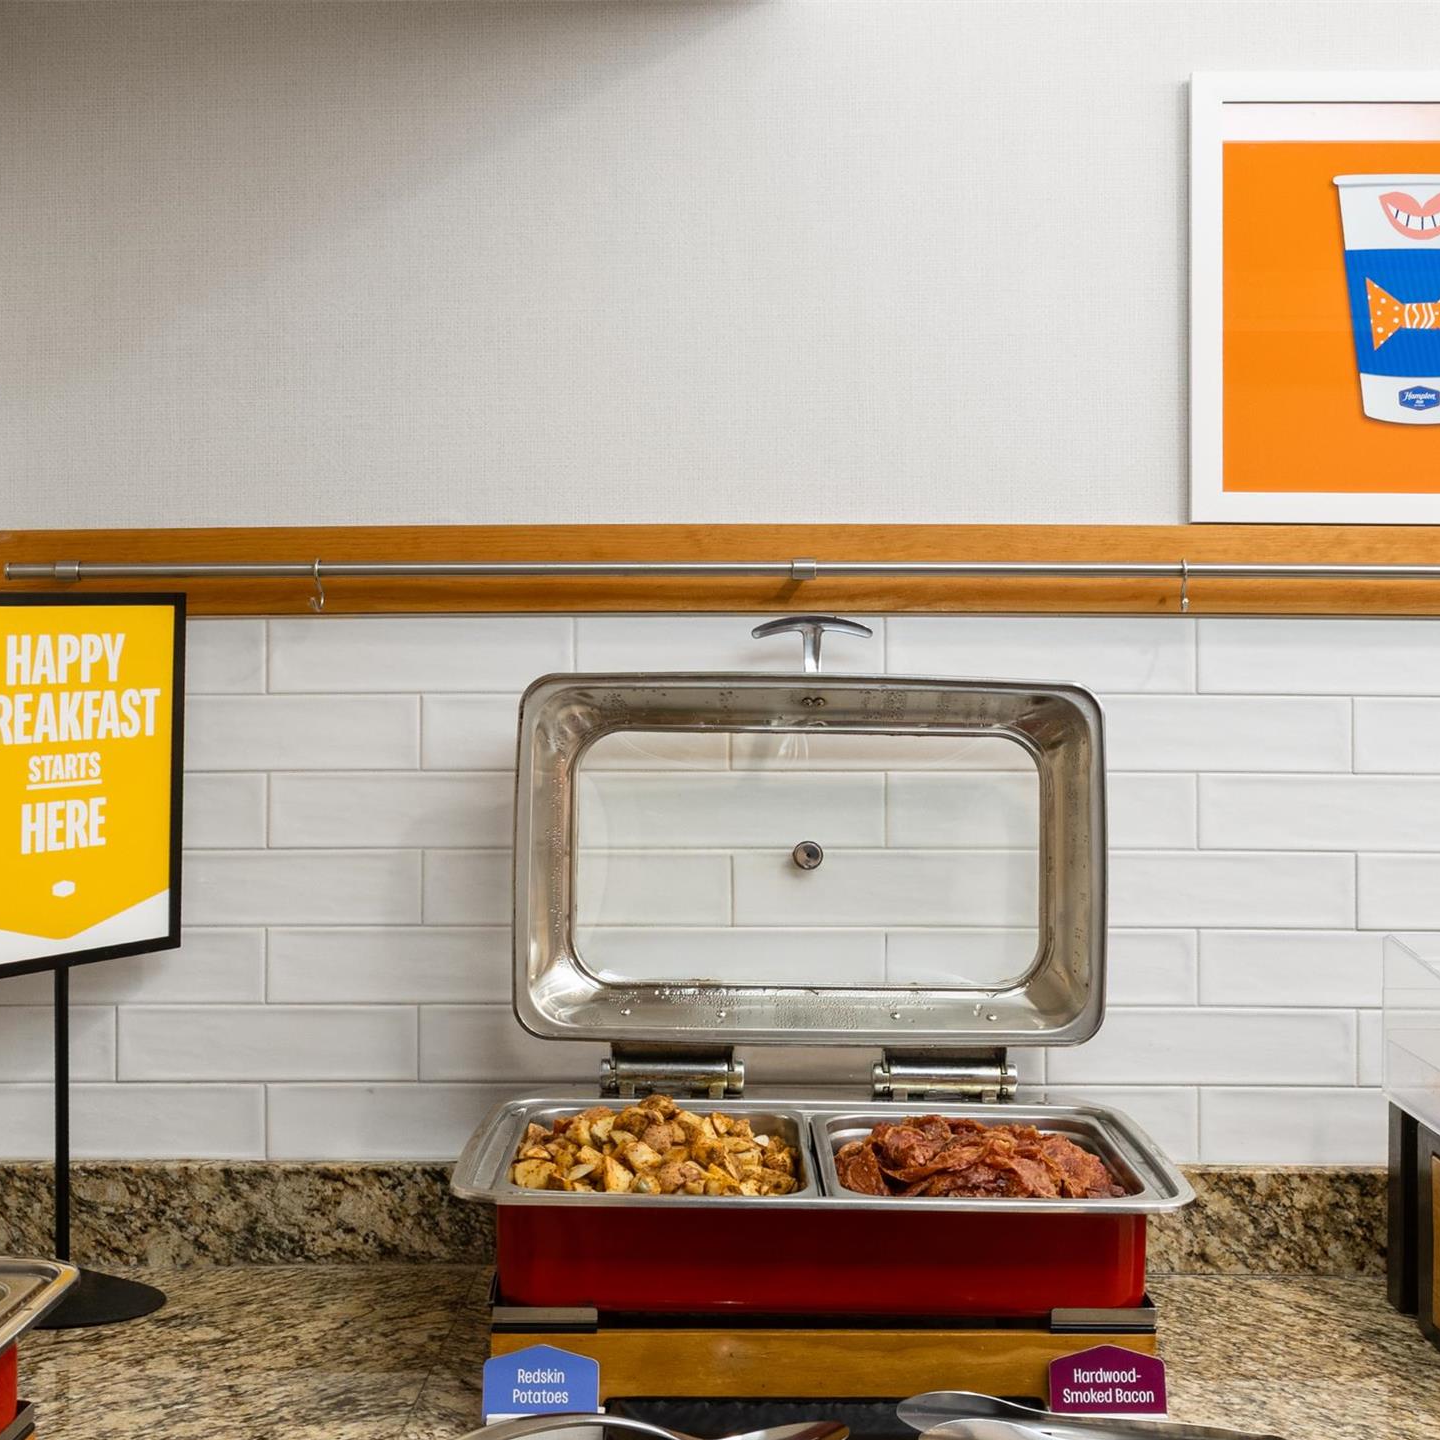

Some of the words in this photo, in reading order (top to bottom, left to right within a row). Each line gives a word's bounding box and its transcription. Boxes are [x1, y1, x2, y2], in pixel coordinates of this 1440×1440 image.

[1402, 391, 1436, 401] Hampton
[5, 633, 125, 686] HAPPY
[28, 751, 102, 782] STARTS
[20, 796, 107, 855] HERE
[517, 1368, 565, 1384] Redskin
[1073, 1367, 1142, 1384] Hardwood-
[512, 1388, 569, 1404] Potatoes
[1063, 1388, 1112, 1404] Smoked
[1115, 1388, 1155, 1403] Bacon
